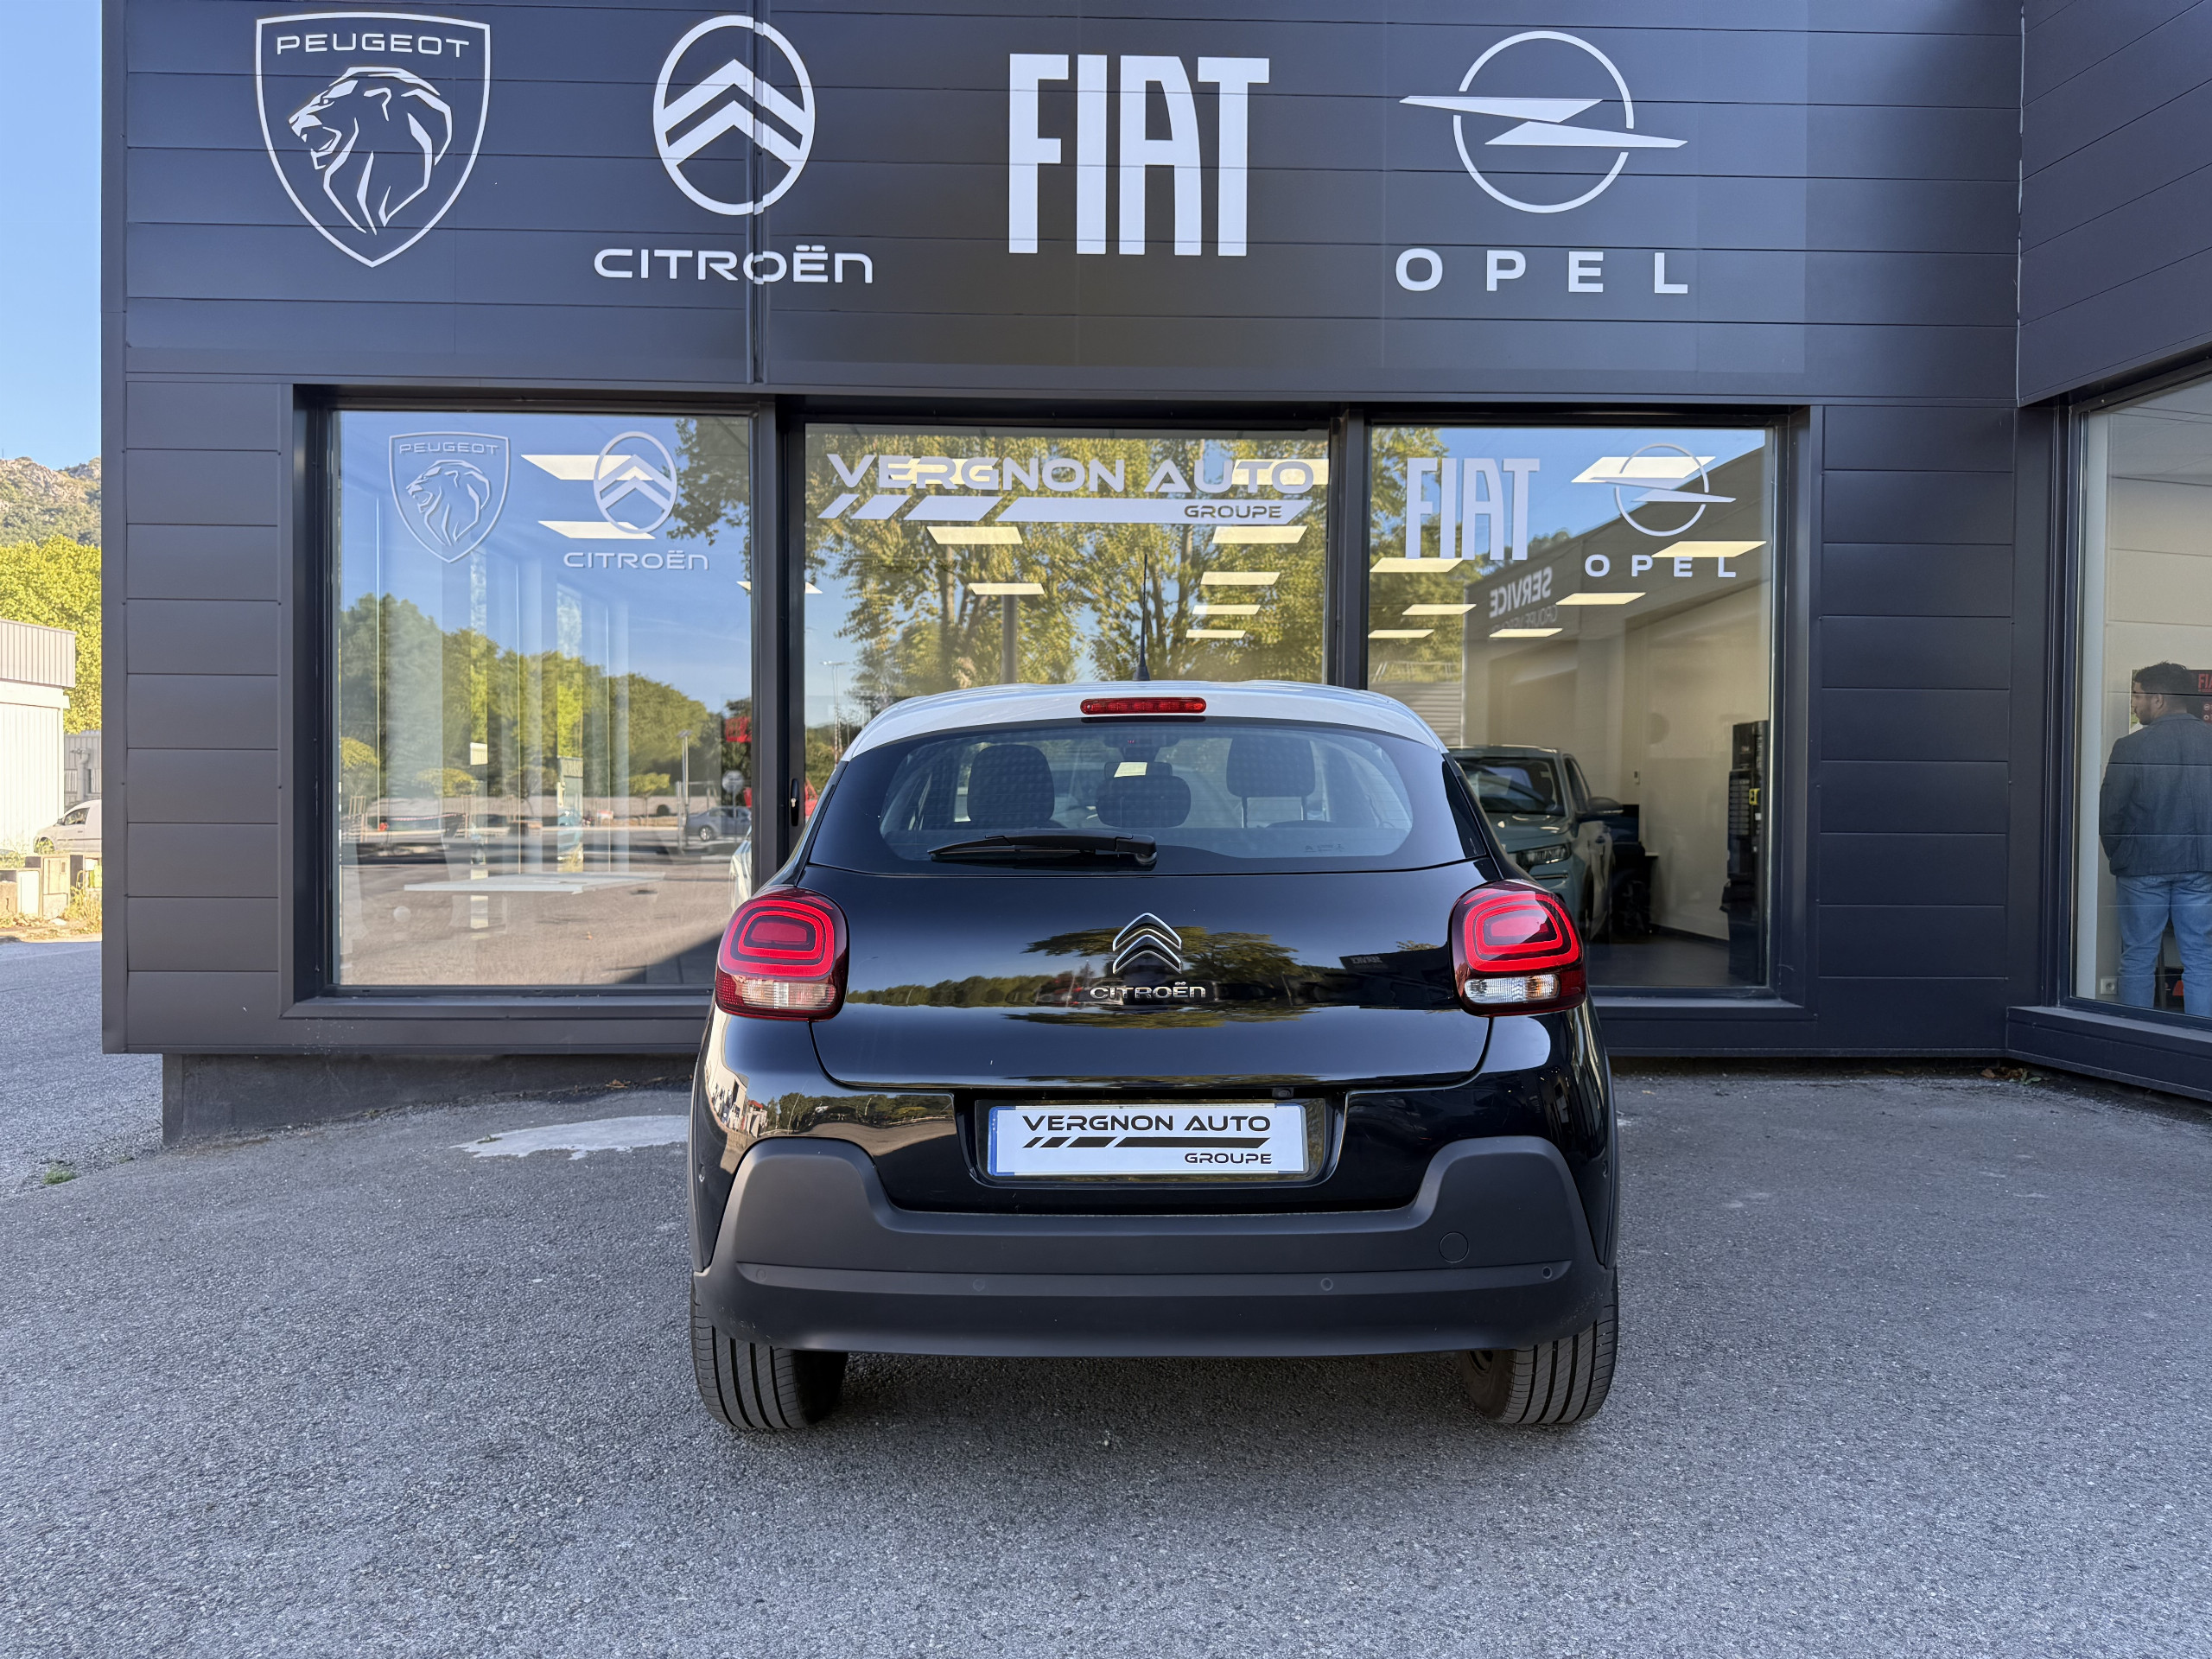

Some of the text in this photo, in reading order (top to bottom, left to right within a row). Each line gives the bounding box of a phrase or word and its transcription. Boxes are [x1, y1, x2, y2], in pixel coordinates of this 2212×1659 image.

[276, 33, 470, 59] PEUGEOT
[1008, 54, 1269, 257] FIAT
[594, 245, 874, 285] CITROËN
[1395, 248, 1688, 294] OPEL
[399, 442, 499, 455] PEUGEOT
[827, 454, 1314, 494] VERGNON AUTO
[1184, 505, 1282, 518] GROUPE
[1404, 457, 1540, 560] FIAT
[563, 550, 709, 570] CITROËN
[1585, 554, 1737, 577] OPEL
[1090, 982, 1206, 1000] CITROËN
[1022, 1115, 1271, 1132] VERGNON AUTO
[1184, 1153, 1273, 1165] GROUPE
